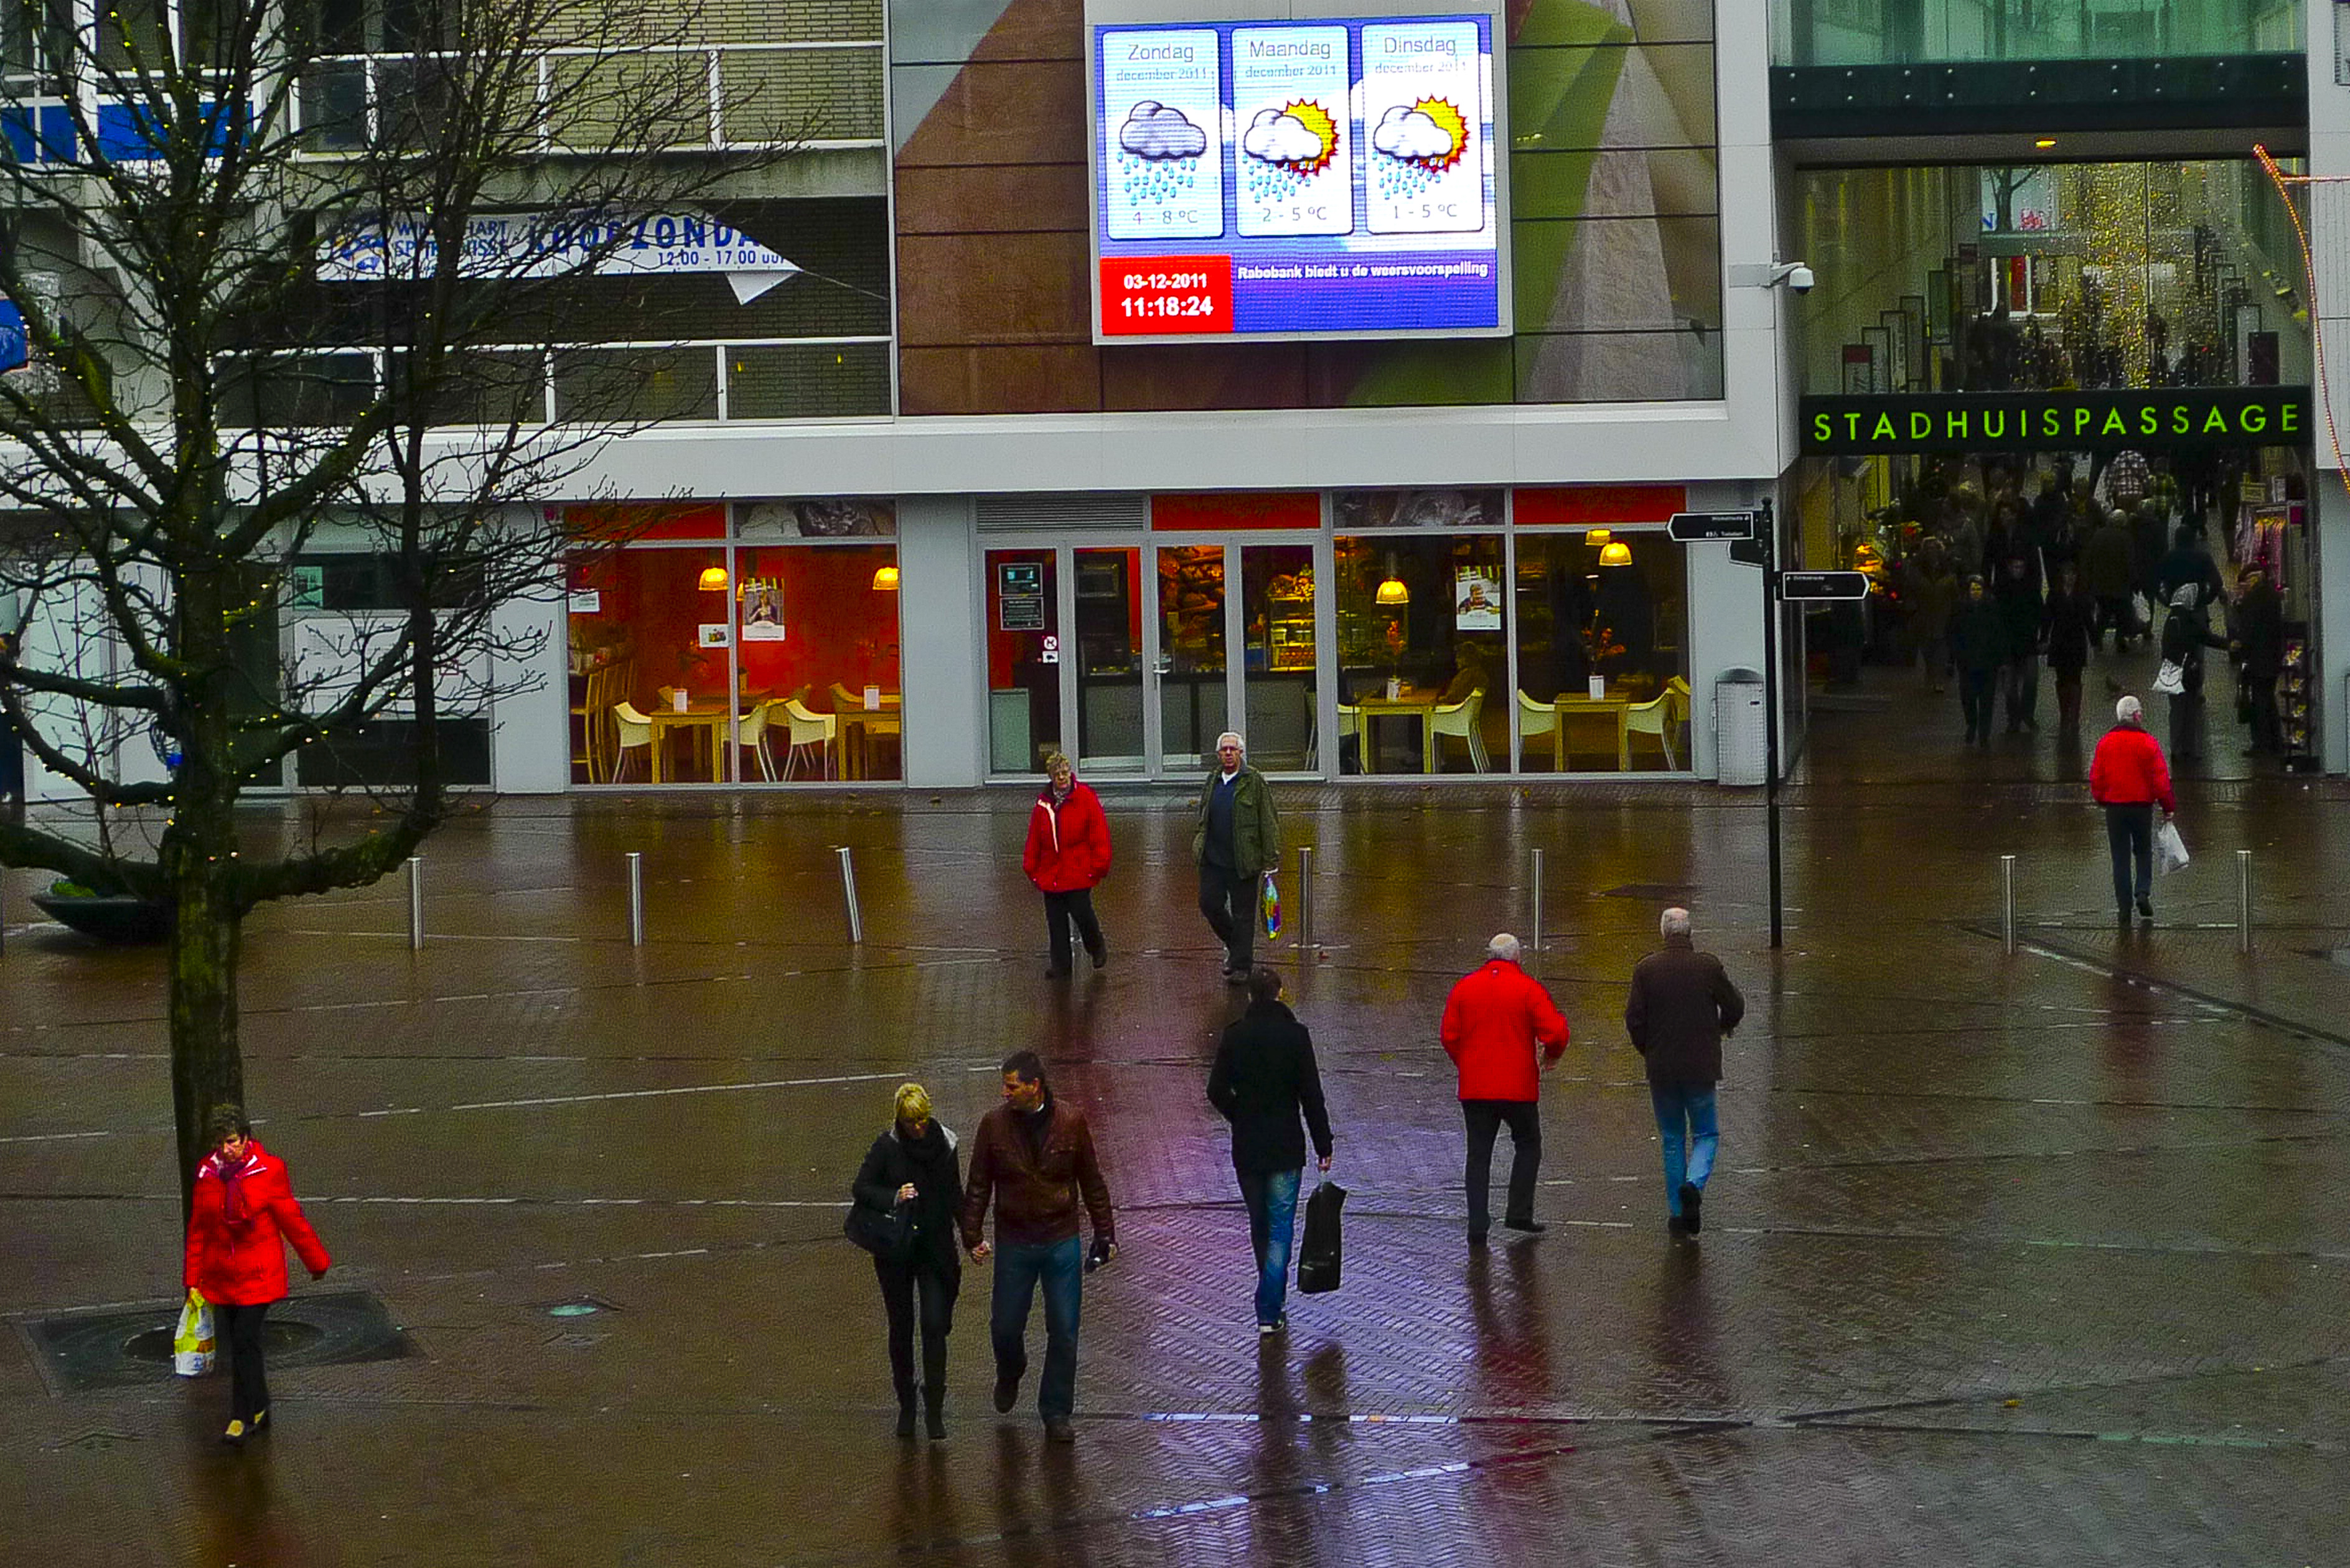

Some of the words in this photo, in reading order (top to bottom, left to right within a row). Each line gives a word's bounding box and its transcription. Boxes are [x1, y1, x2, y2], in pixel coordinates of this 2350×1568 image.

[1128, 43, 1194, 63] Zondag
[1250, 39, 1331, 59] Maandag
[1385, 35, 1456, 56] Dinsdag
[1116, 68, 1175, 82] december
[1178, 67, 1207, 79] 2011
[1245, 64, 1304, 78] december
[1307, 64, 1336, 75] 2011
[1375, 62, 1433, 74] december
[1132, 211, 1145, 225] 4
[1162, 210, 1173, 225] 8
[1262, 207, 1272, 223] 2
[1293, 207, 1301, 222] 5
[1393, 205, 1400, 219] 1
[1422, 204, 1431, 218] 5
[657, 250, 700, 266] 12.00
[716, 250, 756, 265] 17.00
[1237, 264, 1303, 280] Rabobank
[1340, 266, 1349, 278] u
[1123, 273, 1208, 289] 03-12-2011
[1121, 296, 1214, 317] 11:18:24
[1814, 403, 2300, 442] STADHUISPASSAGE
